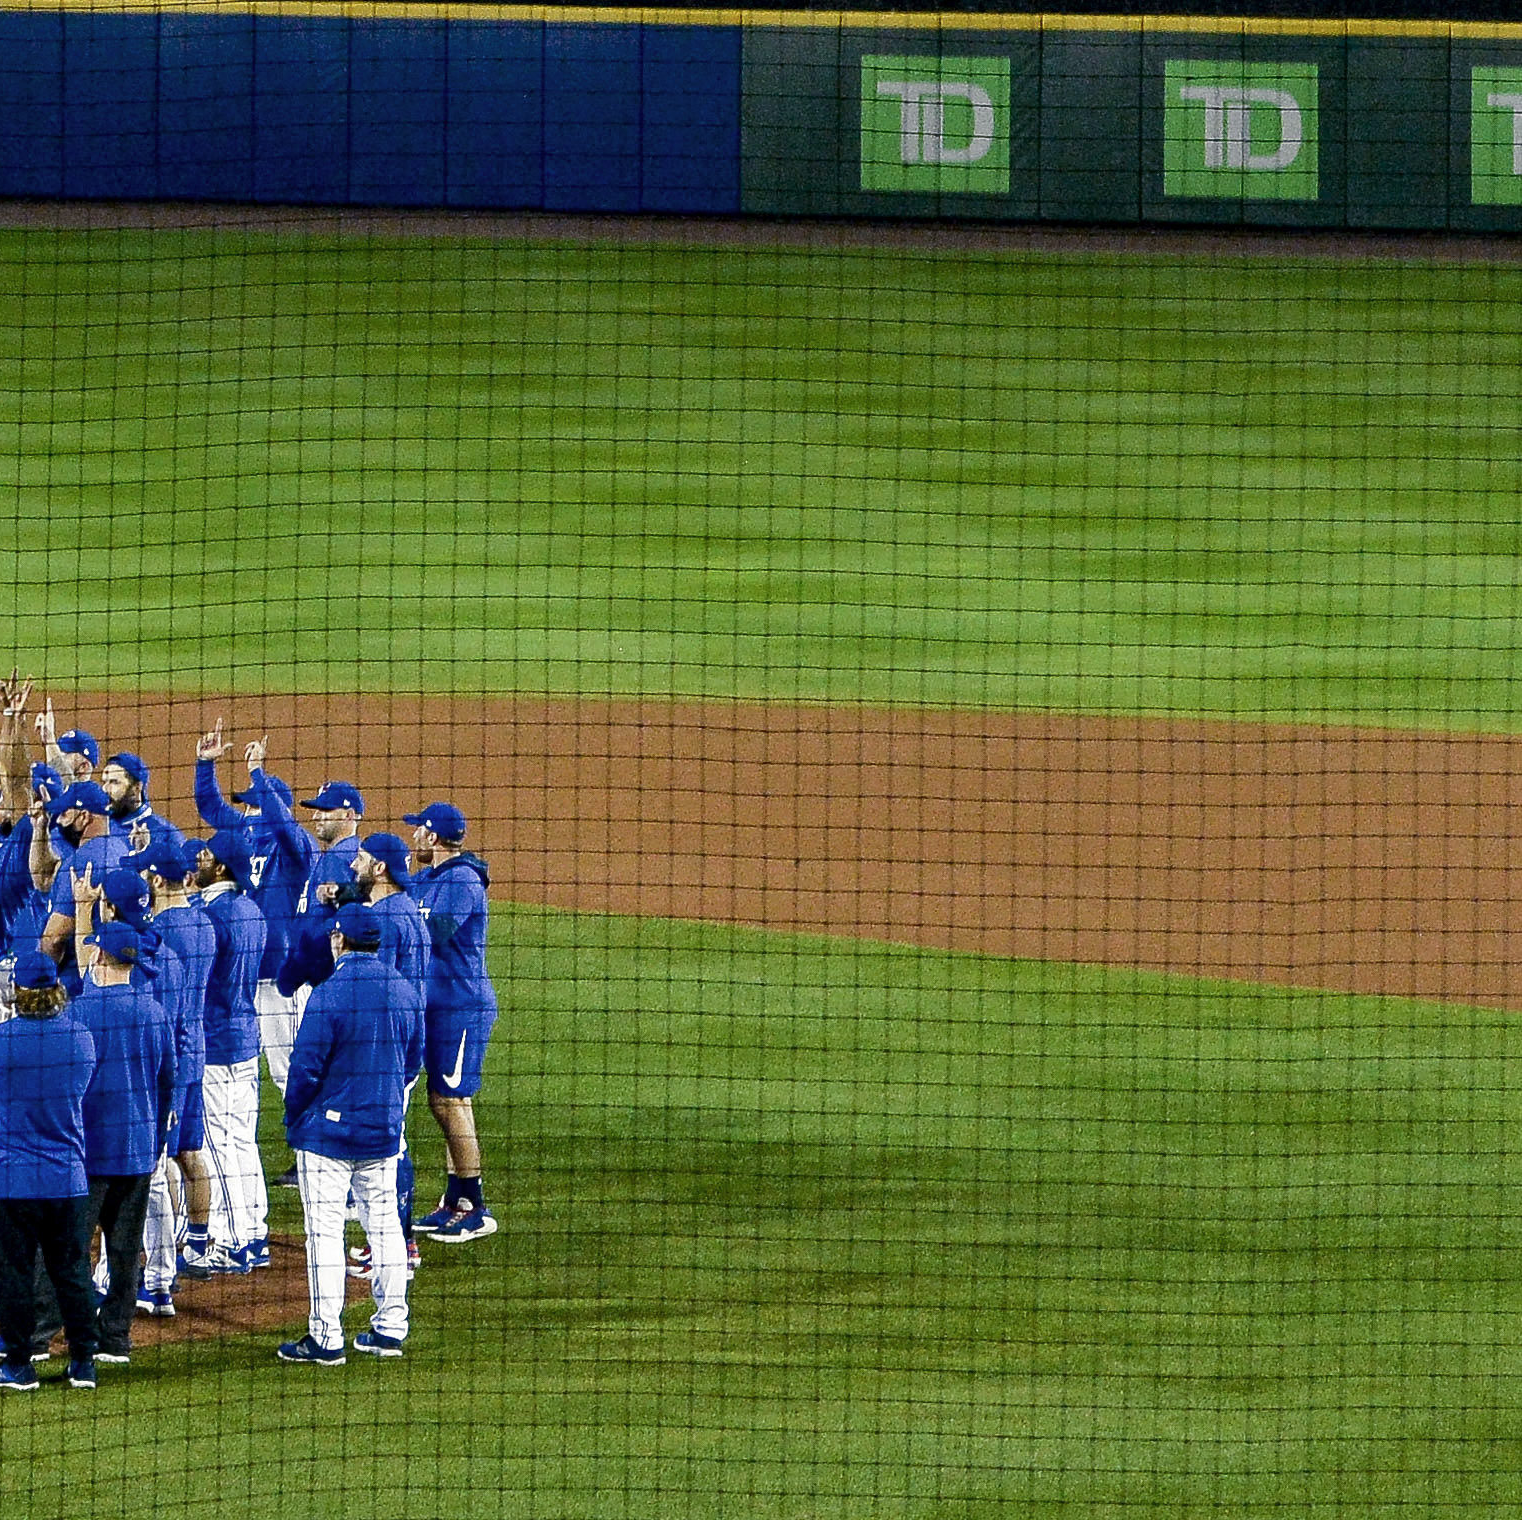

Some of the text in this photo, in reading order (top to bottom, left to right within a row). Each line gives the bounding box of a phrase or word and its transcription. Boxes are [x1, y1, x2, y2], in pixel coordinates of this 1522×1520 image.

[876, 81, 996, 165] TD
[1180, 86, 1303, 170] TD
[1487, 94, 1522, 175] T
